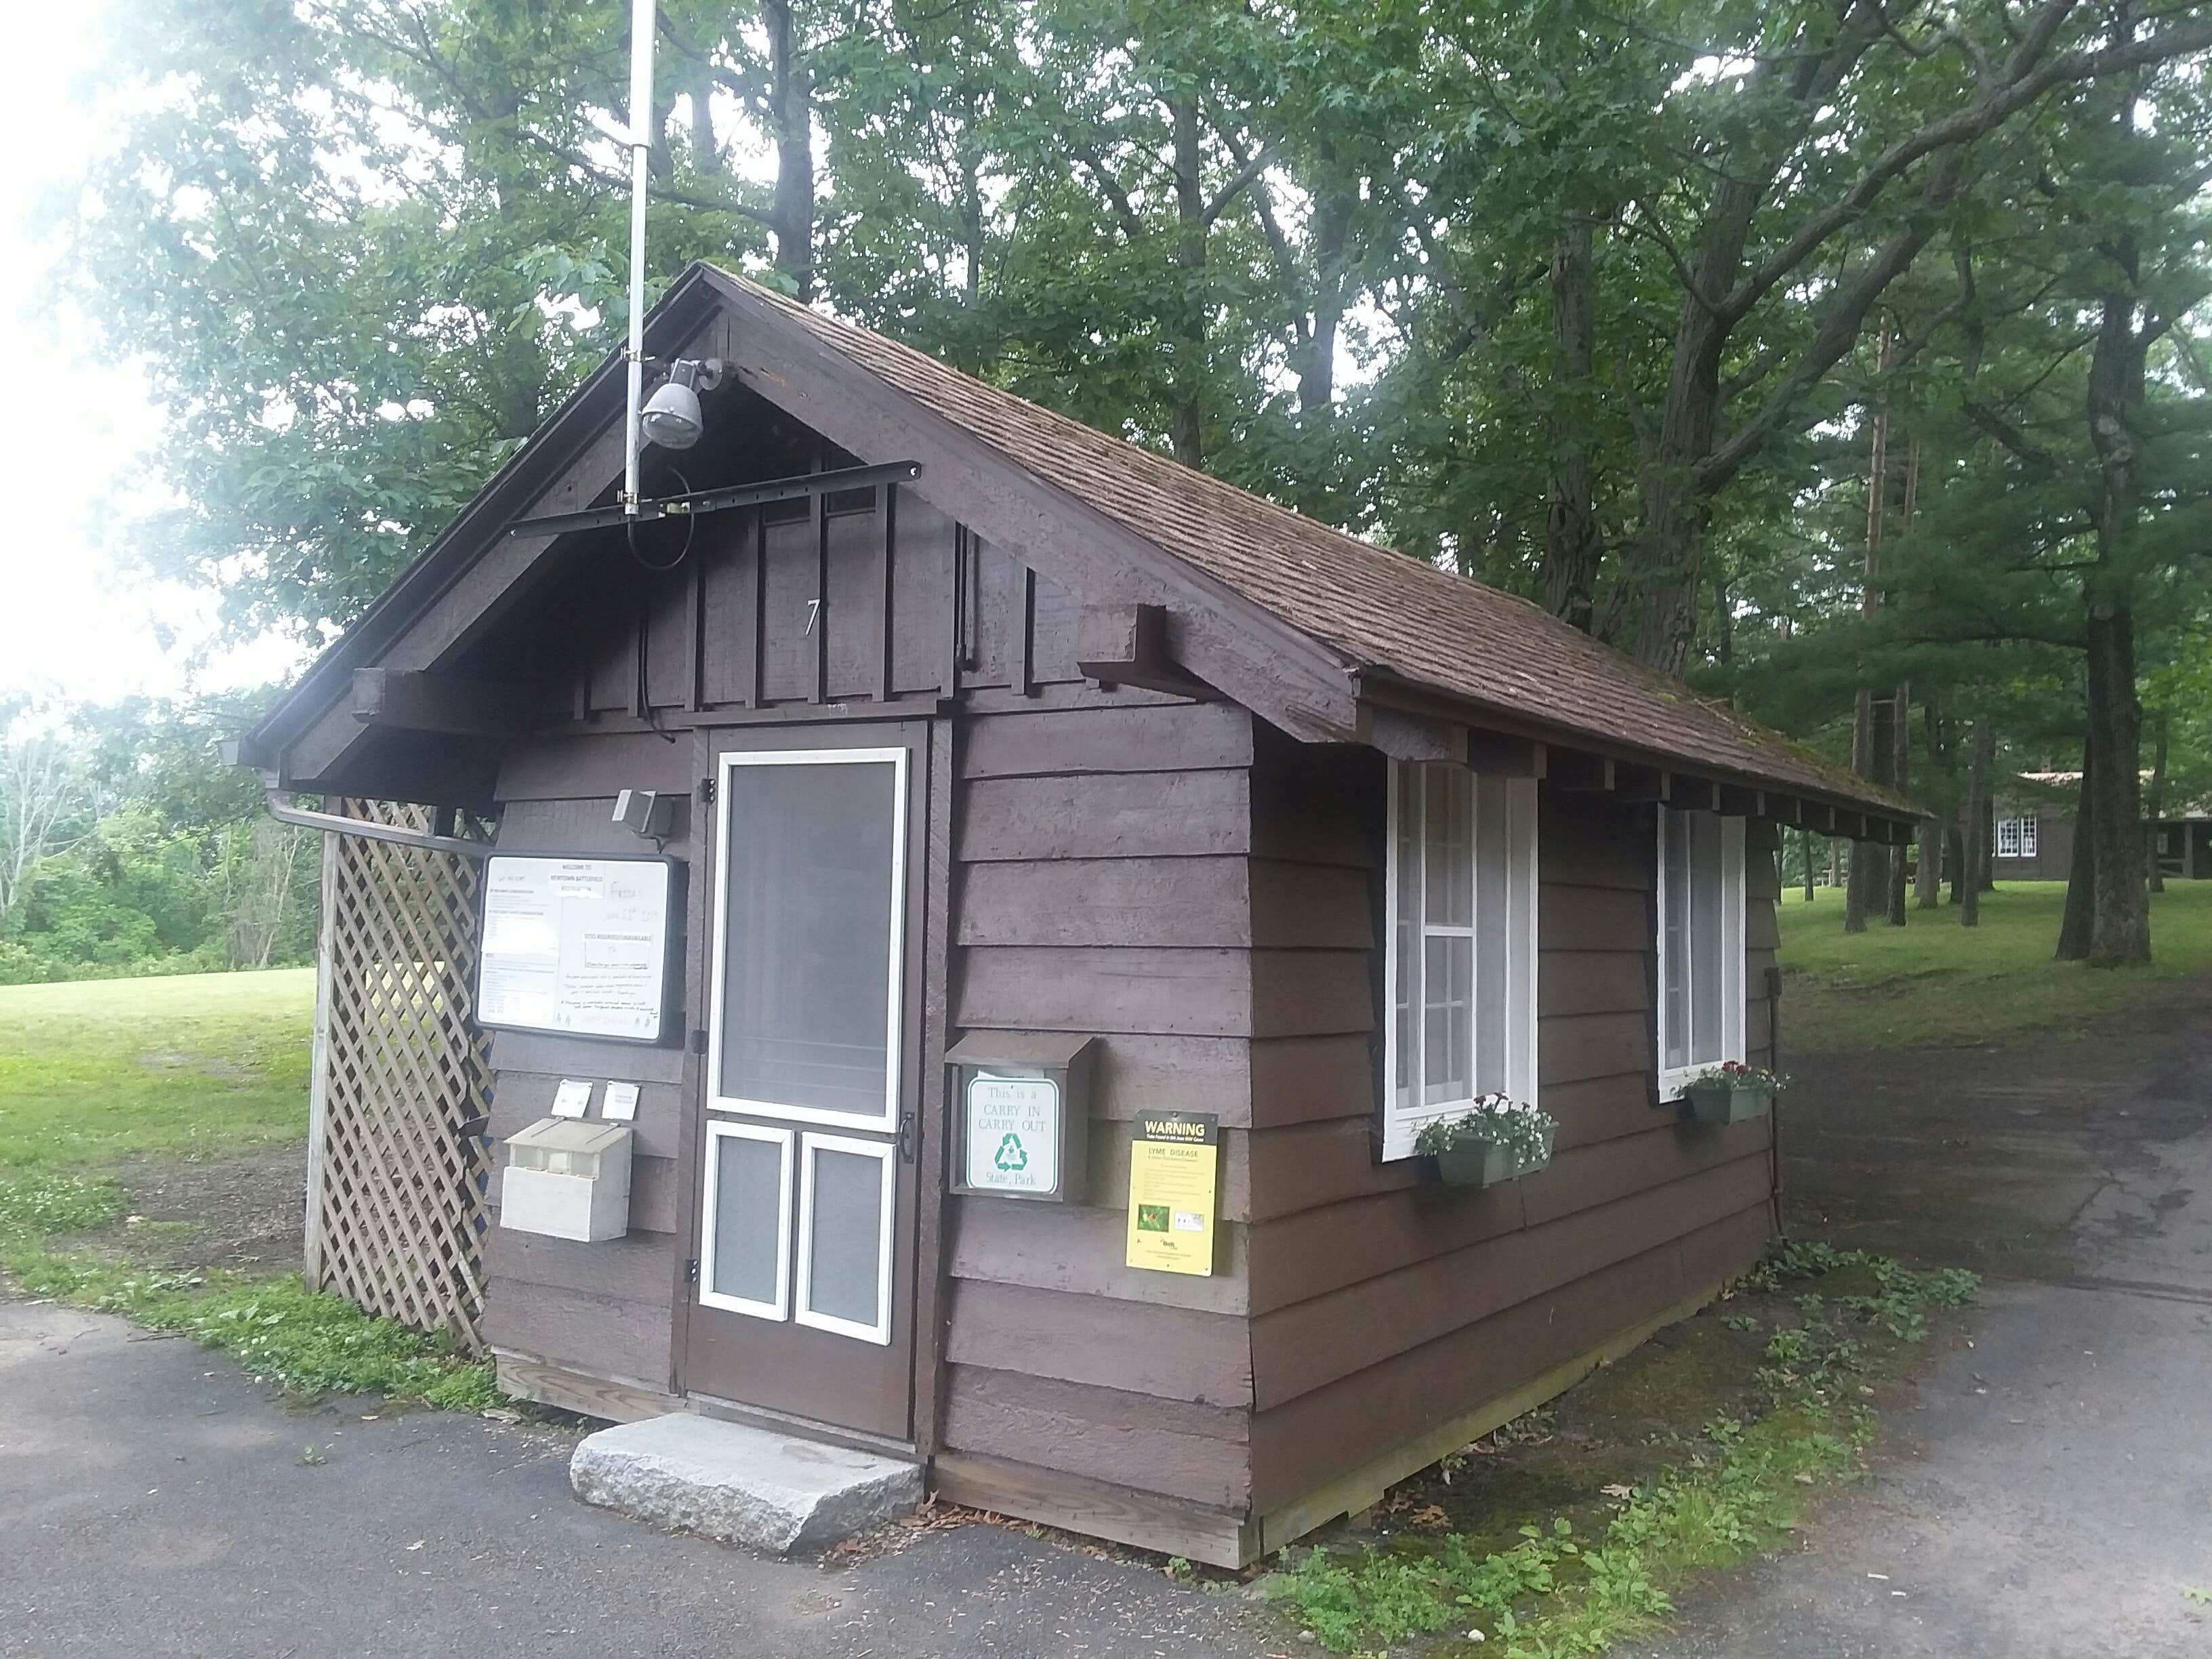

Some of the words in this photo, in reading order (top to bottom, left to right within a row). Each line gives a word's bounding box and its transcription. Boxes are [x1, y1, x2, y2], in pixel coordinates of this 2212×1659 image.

[805, 599, 820, 636] 7
[989, 1087, 1010, 1099] This
[1017, 1090, 1025, 1099] is
[1031, 1091, 1036, 1099] a
[984, 1104, 1020, 1116] CARRY
[1028, 1105, 1040, 1117] IN
[979, 1119, 1015, 1130] CARRY
[1022, 1120, 1046, 1132] OUT
[1145, 1120, 1205, 1136] WARNING
[1170, 1149, 1198, 1158] DISEASE
[986, 1172, 1008, 1183] State
[1015, 1173, 1036, 1185] Park
